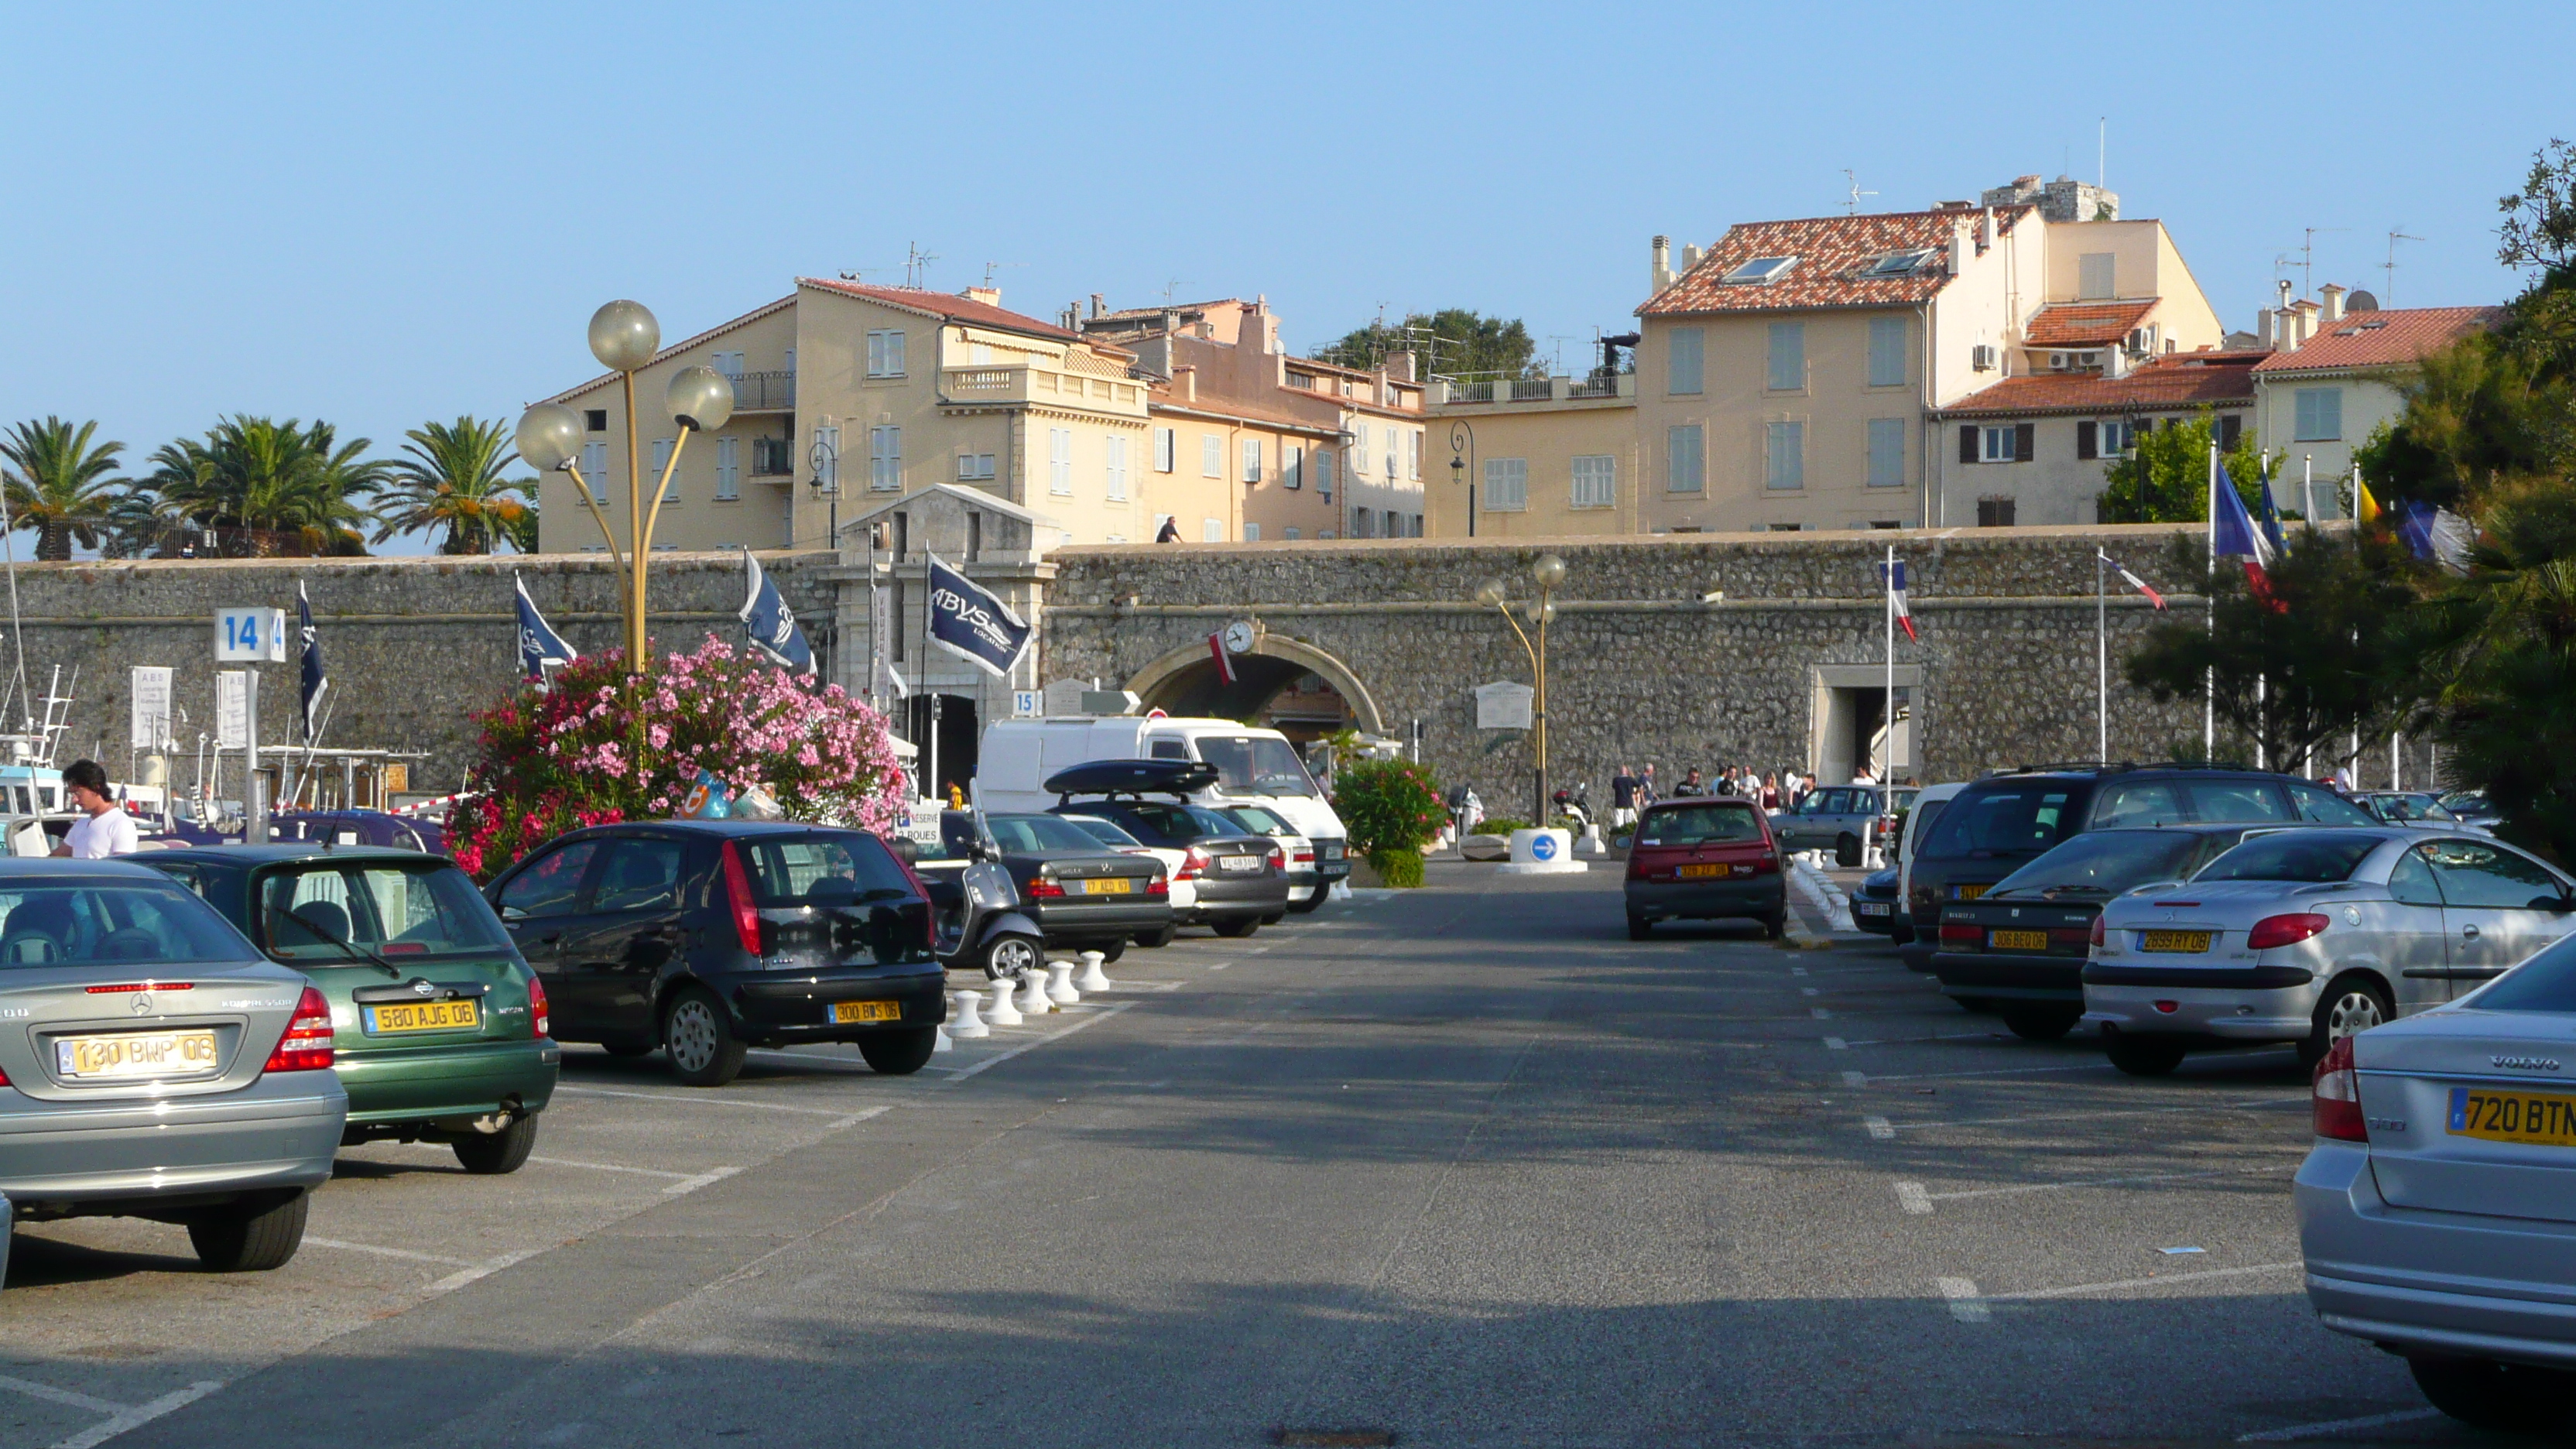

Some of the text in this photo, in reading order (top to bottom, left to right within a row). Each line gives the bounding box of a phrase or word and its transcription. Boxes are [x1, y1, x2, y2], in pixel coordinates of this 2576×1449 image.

[225, 615, 259, 651] 14
[271, 616, 283, 651] 14
[973, 627, 1008, 653] LOCATION
[229, 677, 245, 686] AB
[1017, 694, 1033, 712] 15
[907, 831, 937, 841] ROUES
[0, 1008, 29, 1017] 00
[381, 1003, 474, 1028] 580 AJG 06
[838, 1005, 860, 1020] 300
[886, 1002, 898, 1017] 06
[79, 1038, 214, 1067] 130 BNP 06
[2489, 1055, 2561, 1071] VOLVO
[2469, 1096, 2519, 1132] 720
